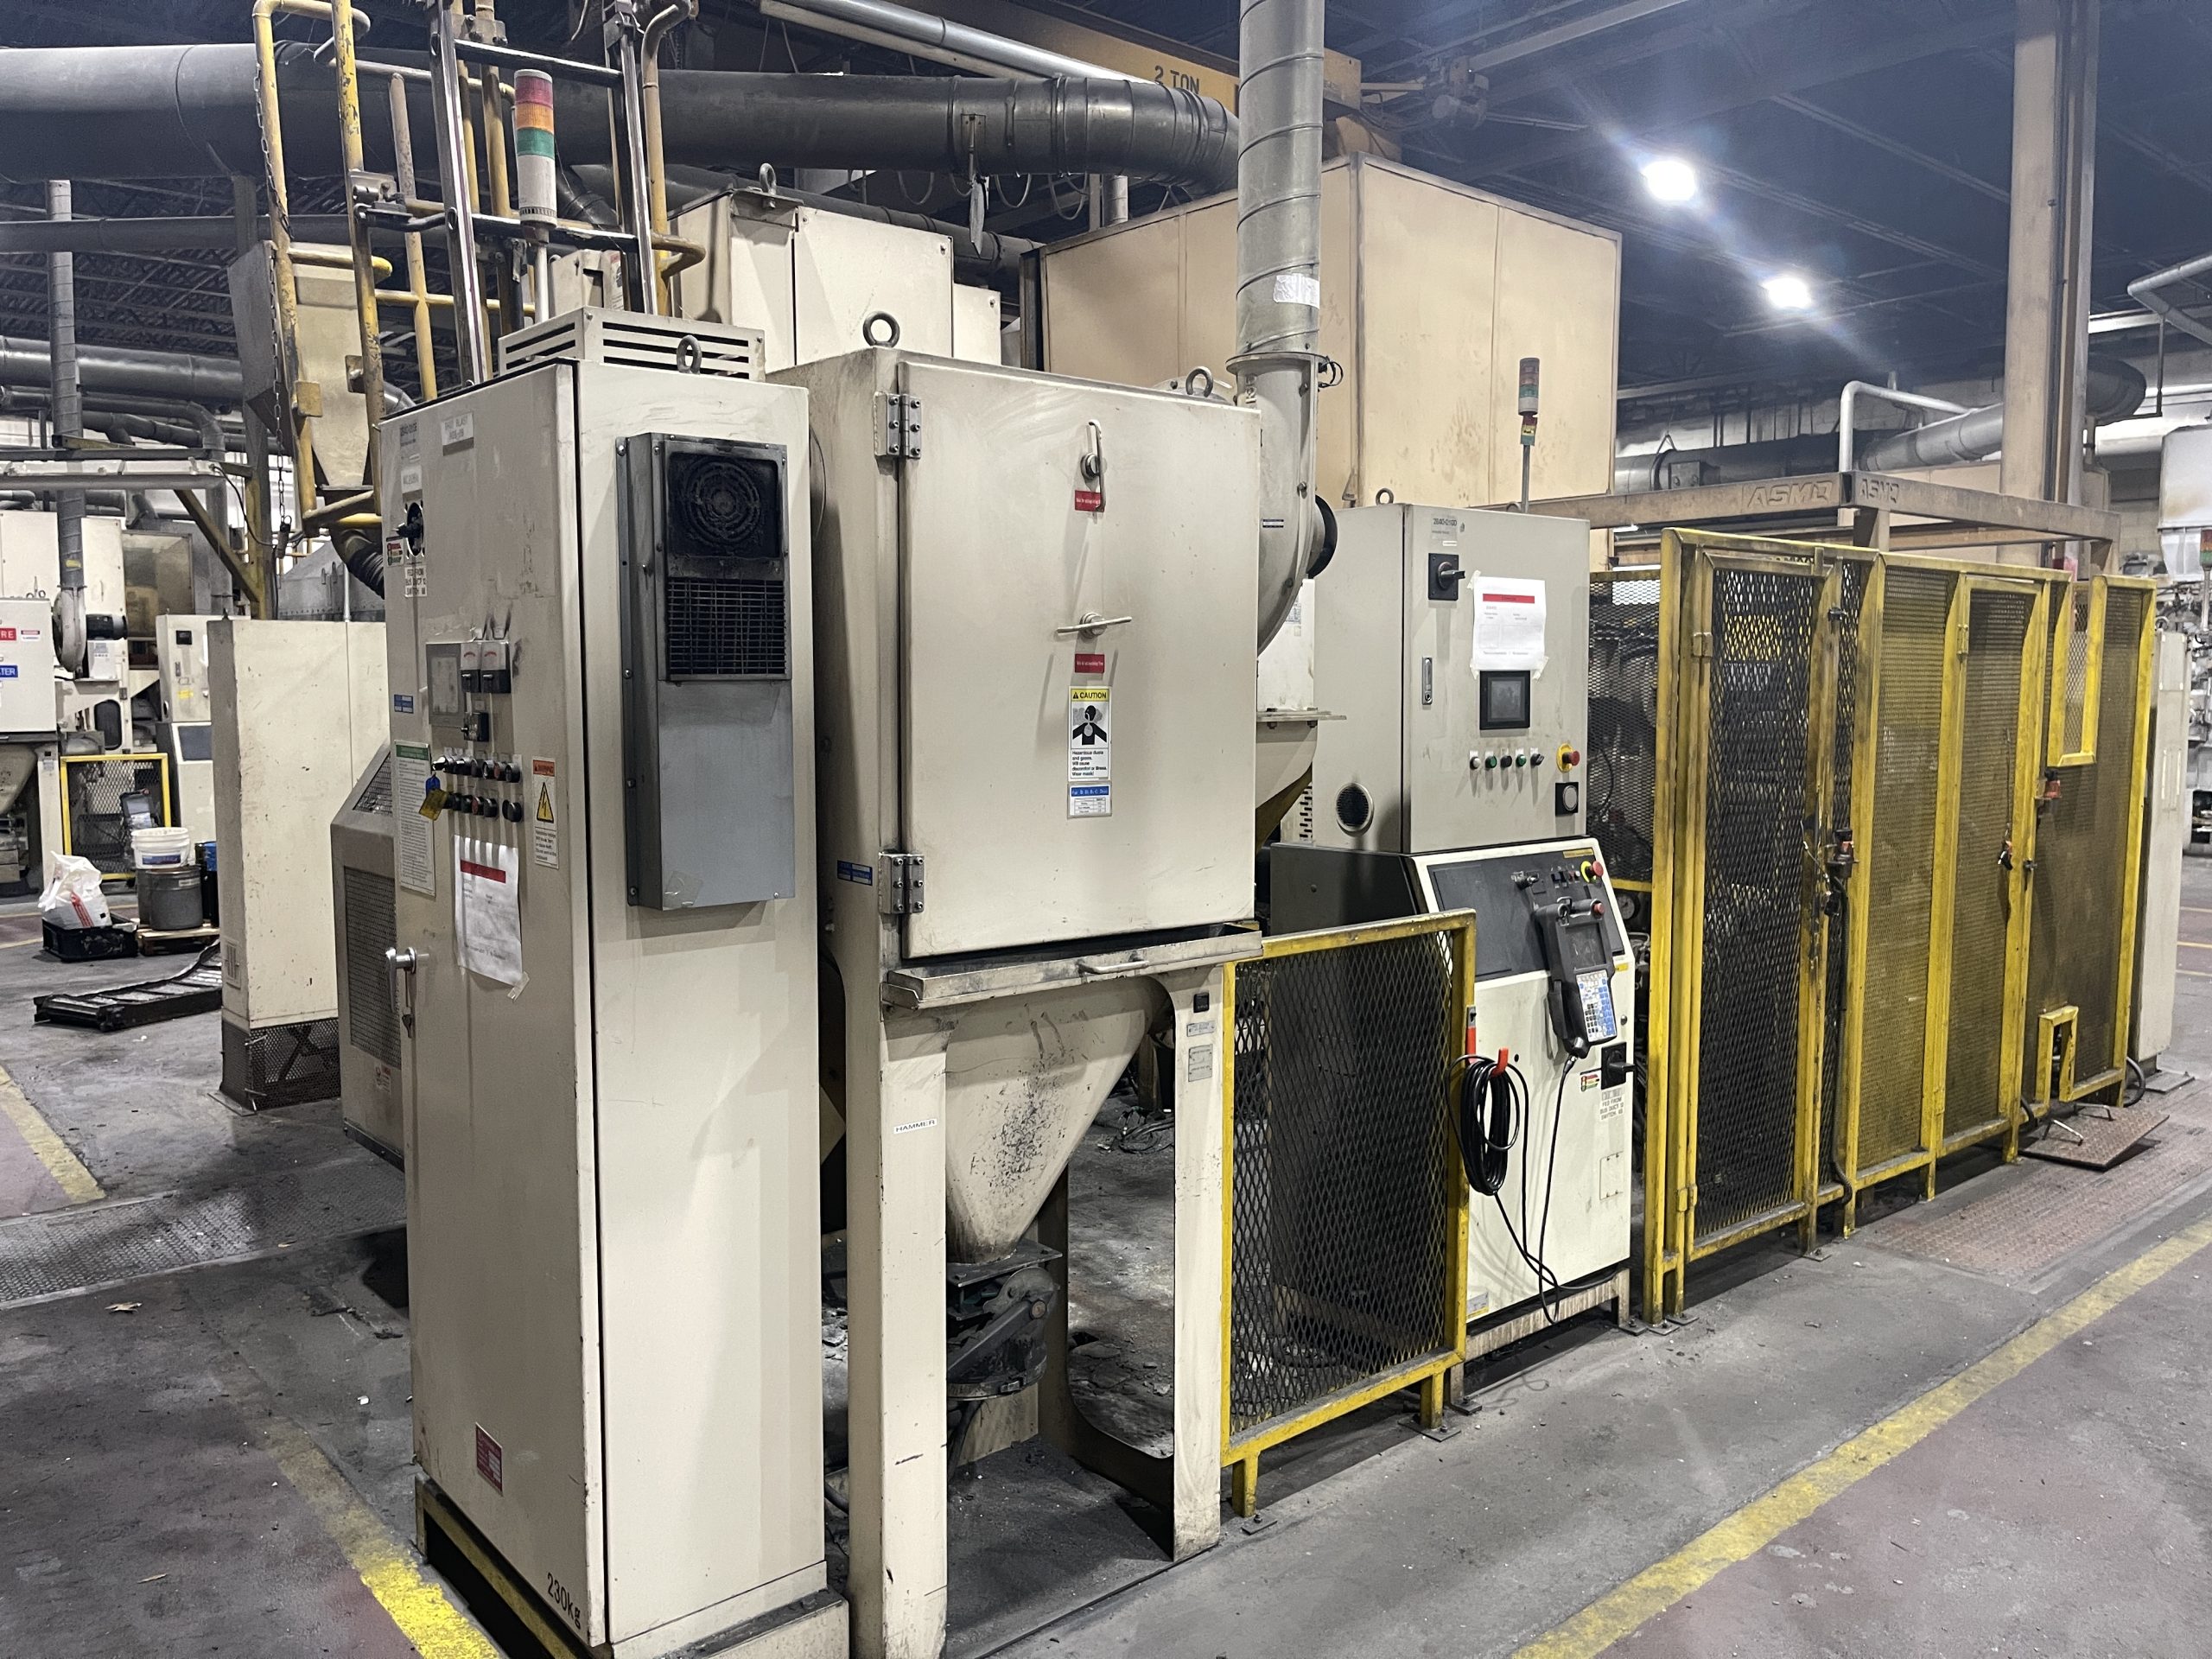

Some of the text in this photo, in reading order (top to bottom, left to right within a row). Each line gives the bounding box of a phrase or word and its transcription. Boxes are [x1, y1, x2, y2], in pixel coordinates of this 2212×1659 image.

[1154, 65, 1199, 94] 2 TON
[895, 1120, 935, 1133] HAMMER
[547, 1571, 582, 1630] 230kg
